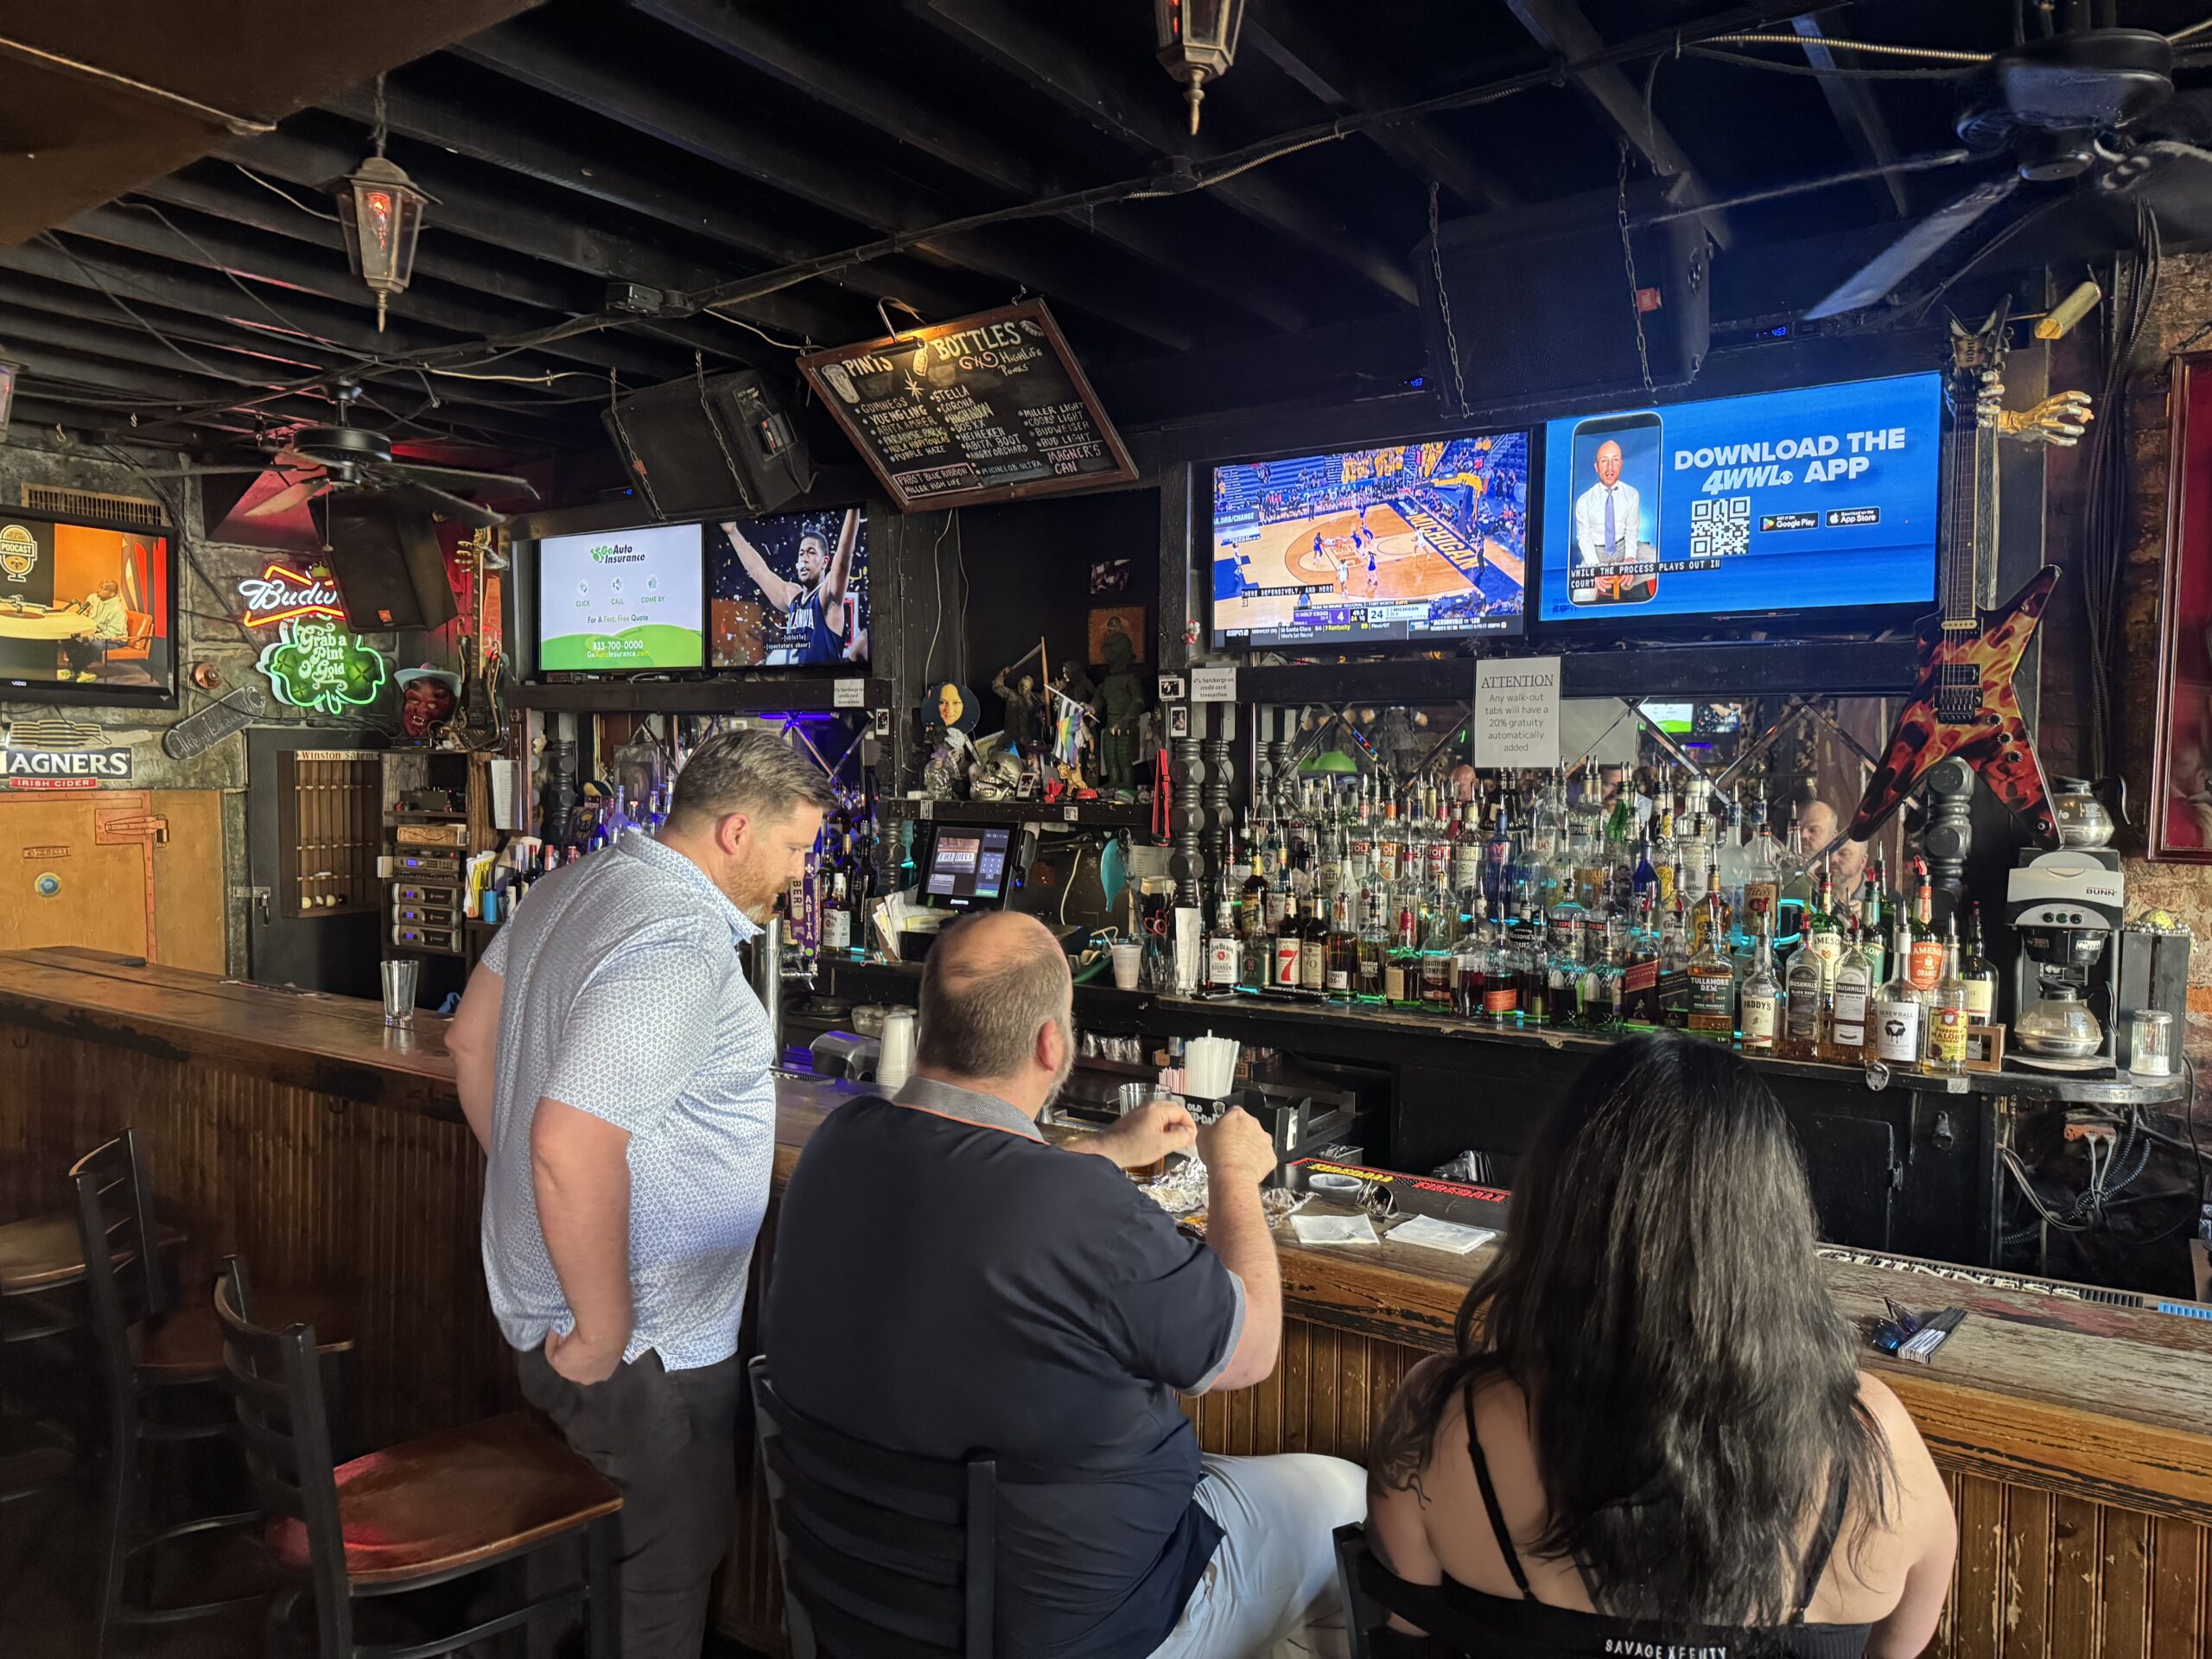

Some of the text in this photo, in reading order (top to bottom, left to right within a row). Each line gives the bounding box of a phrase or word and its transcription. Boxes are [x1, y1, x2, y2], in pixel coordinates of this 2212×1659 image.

[931, 321, 1021, 360] BOTTLES
[842, 355, 893, 377] PINTS
[933, 384, 970, 403] STELLA
[940, 397, 976, 413] CORONA
[1023, 402, 1084, 417] MILLER LIGHT
[868, 404, 928, 425] YUENGLING
[1027, 410, 1084, 427] COORS LIGHT
[876, 416, 938, 436] ABITA AMBER
[955, 419, 986, 433] DOS XX
[1034, 421, 1090, 436] BUDWEISER
[960, 427, 1006, 442] HEINEKEN
[1040, 432, 1091, 447] BUD LIGHT
[965, 434, 1021, 451] ABITA BOOT
[1675, 428, 1906, 470] DOWNLOAD THE
[894, 445, 946, 461] PURPLE HAZE
[970, 444, 1028, 460] ANGRY ORCHARD
[1046, 444, 1102, 464] MAGNER'S
[982, 460, 1042, 475] MICHELOB ULTRA
[1054, 461, 1077, 474] CAN
[1803, 456, 1870, 483] APP
[898, 467, 969, 486] PABST BLUE RIBBON
[905, 478, 962, 495] MILLER HIGH LIFE
[1776, 518, 1815, 529] Google Play
[1, 543, 32, 554] PODCAST
[1406, 512, 1488, 570] MICHIGAN
[601, 544, 632, 556] GoAuto
[605, 554, 645, 564] Insurance
[1571, 559, 1720, 577] WHILE THE PROCESS PLAYS OUT IN
[1242, 589, 1258, 598] THERE
[1305, 585, 1316, 594] AND
[1571, 579, 1595, 589] COURT
[1337, 612, 1344, 621] 4
[1370, 610, 1383, 619] 24
[1328, 623, 1351, 632] Kentucky
[297, 623, 347, 654] Grab a
[593, 639, 644, 651] 833-700-0000
[309, 648, 345, 666] Pint
[587, 650, 651, 658] GoAutoInsurance.com
[1481, 674, 1554, 690] ATTENTION
[1490, 693, 1544, 704] Any walk-out
[1484, 707, 1503, 715] tabs
[1505, 705, 1520, 715] will
[1522, 704, 1541, 715] have
[1489, 718, 1544, 729] 20% gratuity
[1488, 730, 1544, 741] automatically
[1503, 743, 1529, 752] added
[302, 751, 374, 760] Winston Salem
[938, 853, 955, 861] THE
[1746, 887, 1772, 897] Tito's
[1278, 950, 1300, 982] 7
[1691, 976, 1730, 985] TULLAMORE
[1789, 979, 1818, 989] BUSHMILLS
[1836, 984, 1866, 993] BUSHMILLS
[1744, 999, 1772, 1011] PADDY'S
[1879, 1009, 1913, 1018] SKREWBALL
[1187, 1103, 1202, 1113] OLD
[1412, 1181, 1509, 1203] FIREBALL
[1816, 1249, 2081, 1300] GUINNESS
[1605, 1639, 1662, 1659] SAVAGE
